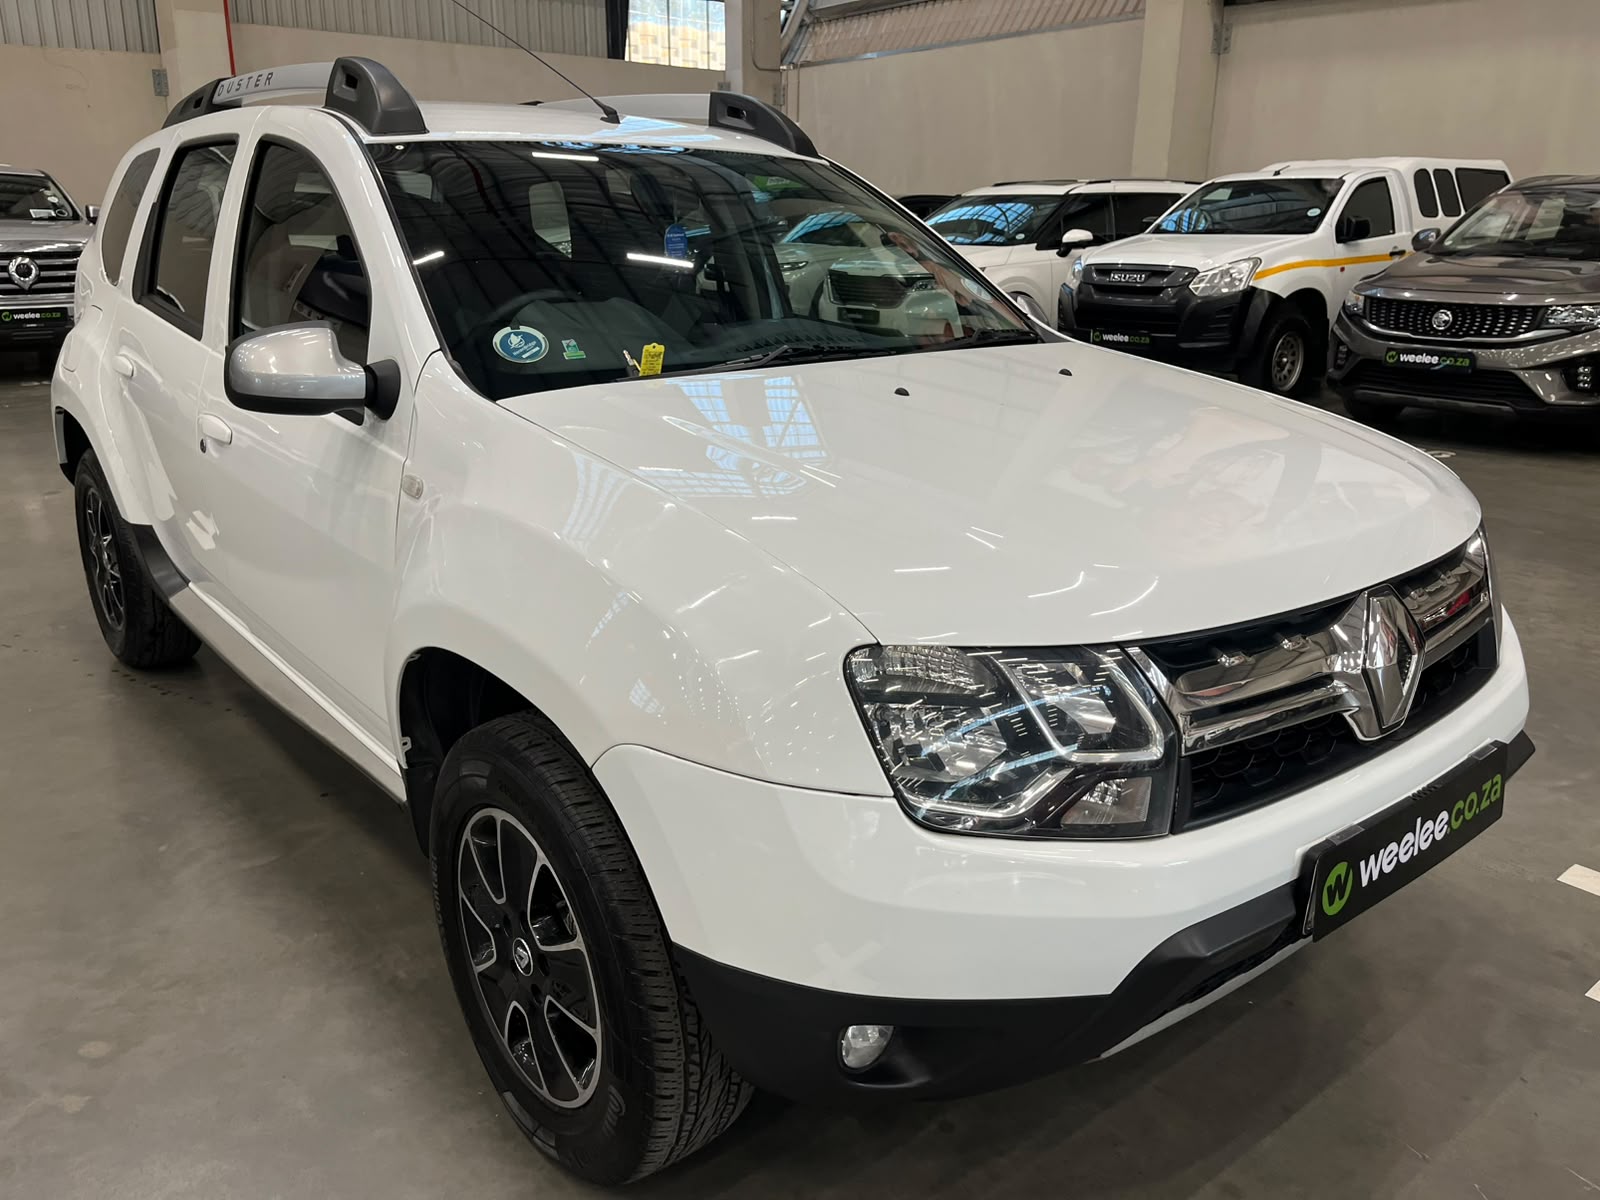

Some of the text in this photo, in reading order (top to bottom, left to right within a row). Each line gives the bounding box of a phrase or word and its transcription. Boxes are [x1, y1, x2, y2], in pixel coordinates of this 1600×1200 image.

[217, 72, 274, 97] DUSTER
[1109, 273, 1146, 283] ISUZU
[1102, 333, 1150, 344] weelee.co.za
[1399, 353, 1470, 367] weelee.co.za
[1359, 773, 1502, 888] weelee.co.za
